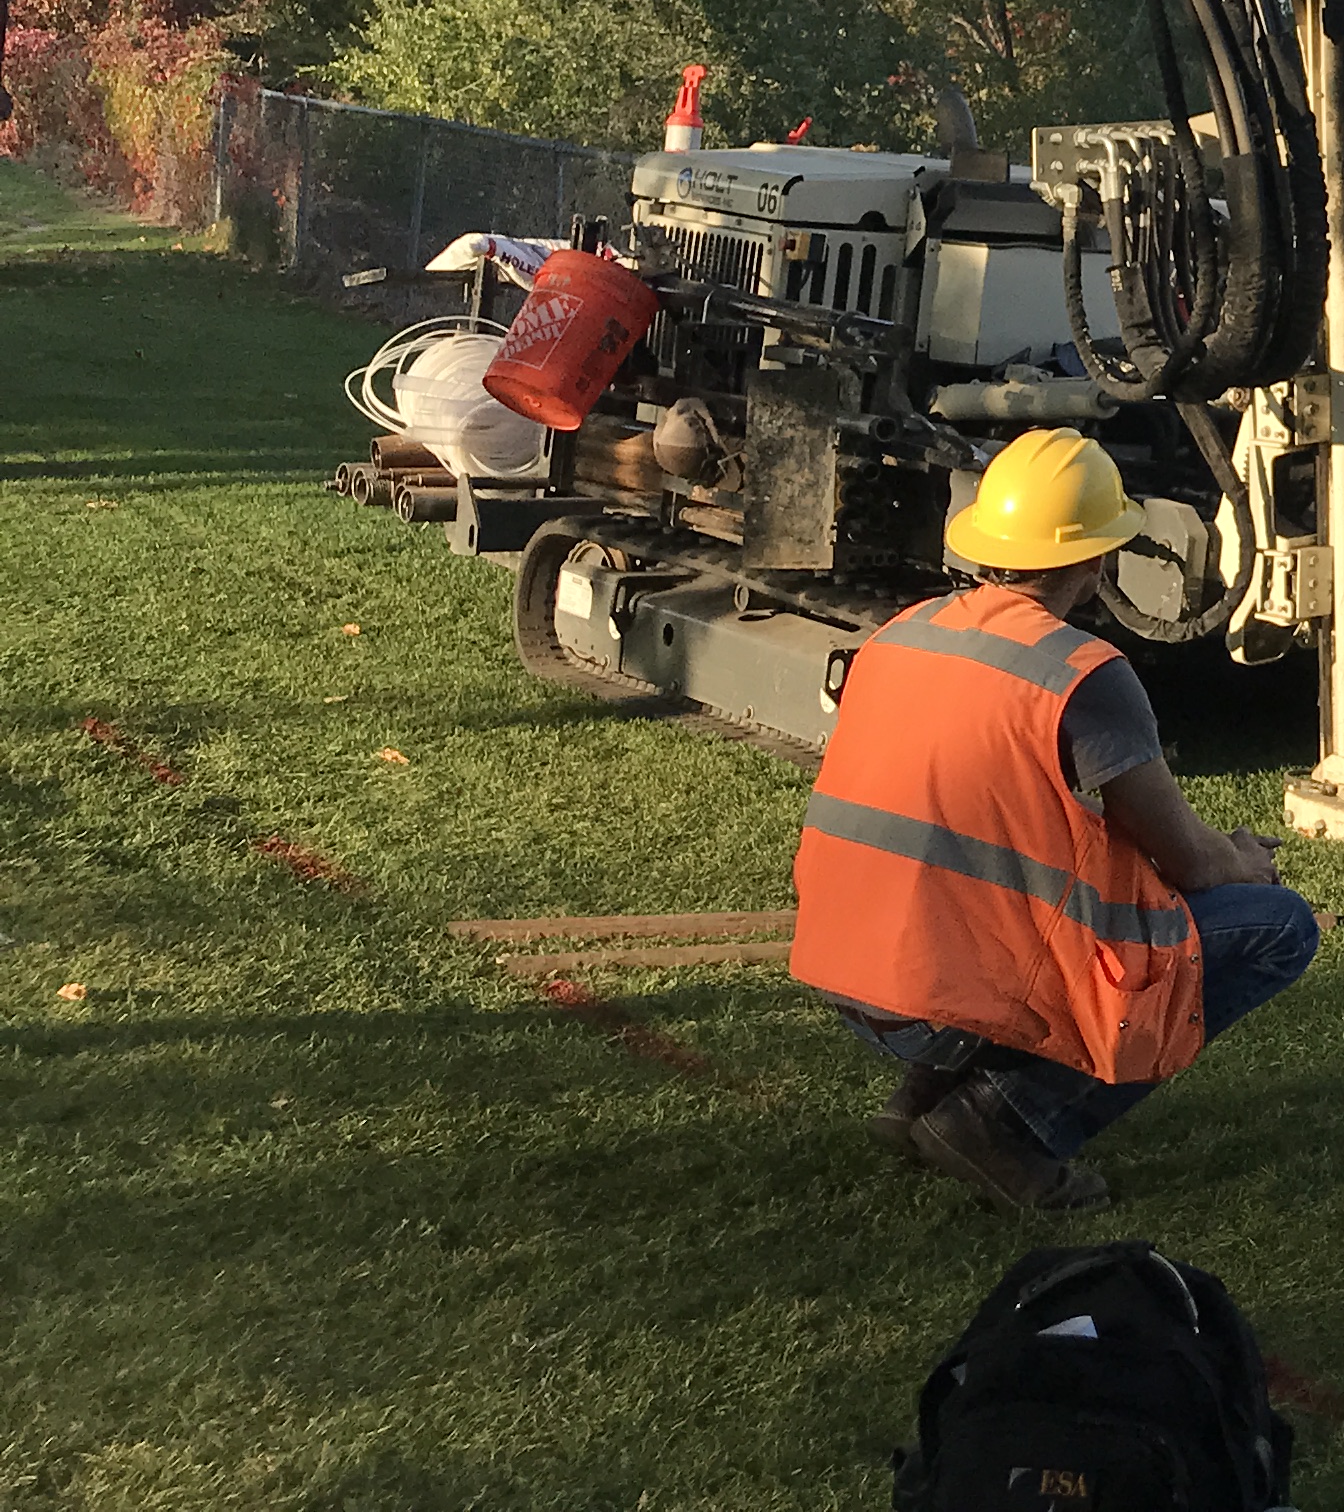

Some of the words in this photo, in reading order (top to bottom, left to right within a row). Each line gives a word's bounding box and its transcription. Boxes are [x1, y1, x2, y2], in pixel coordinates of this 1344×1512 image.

[693, 169, 738, 195] HOLT
[757, 183, 779, 214] 06
[1041, 1469, 1087, 1497] ESA
